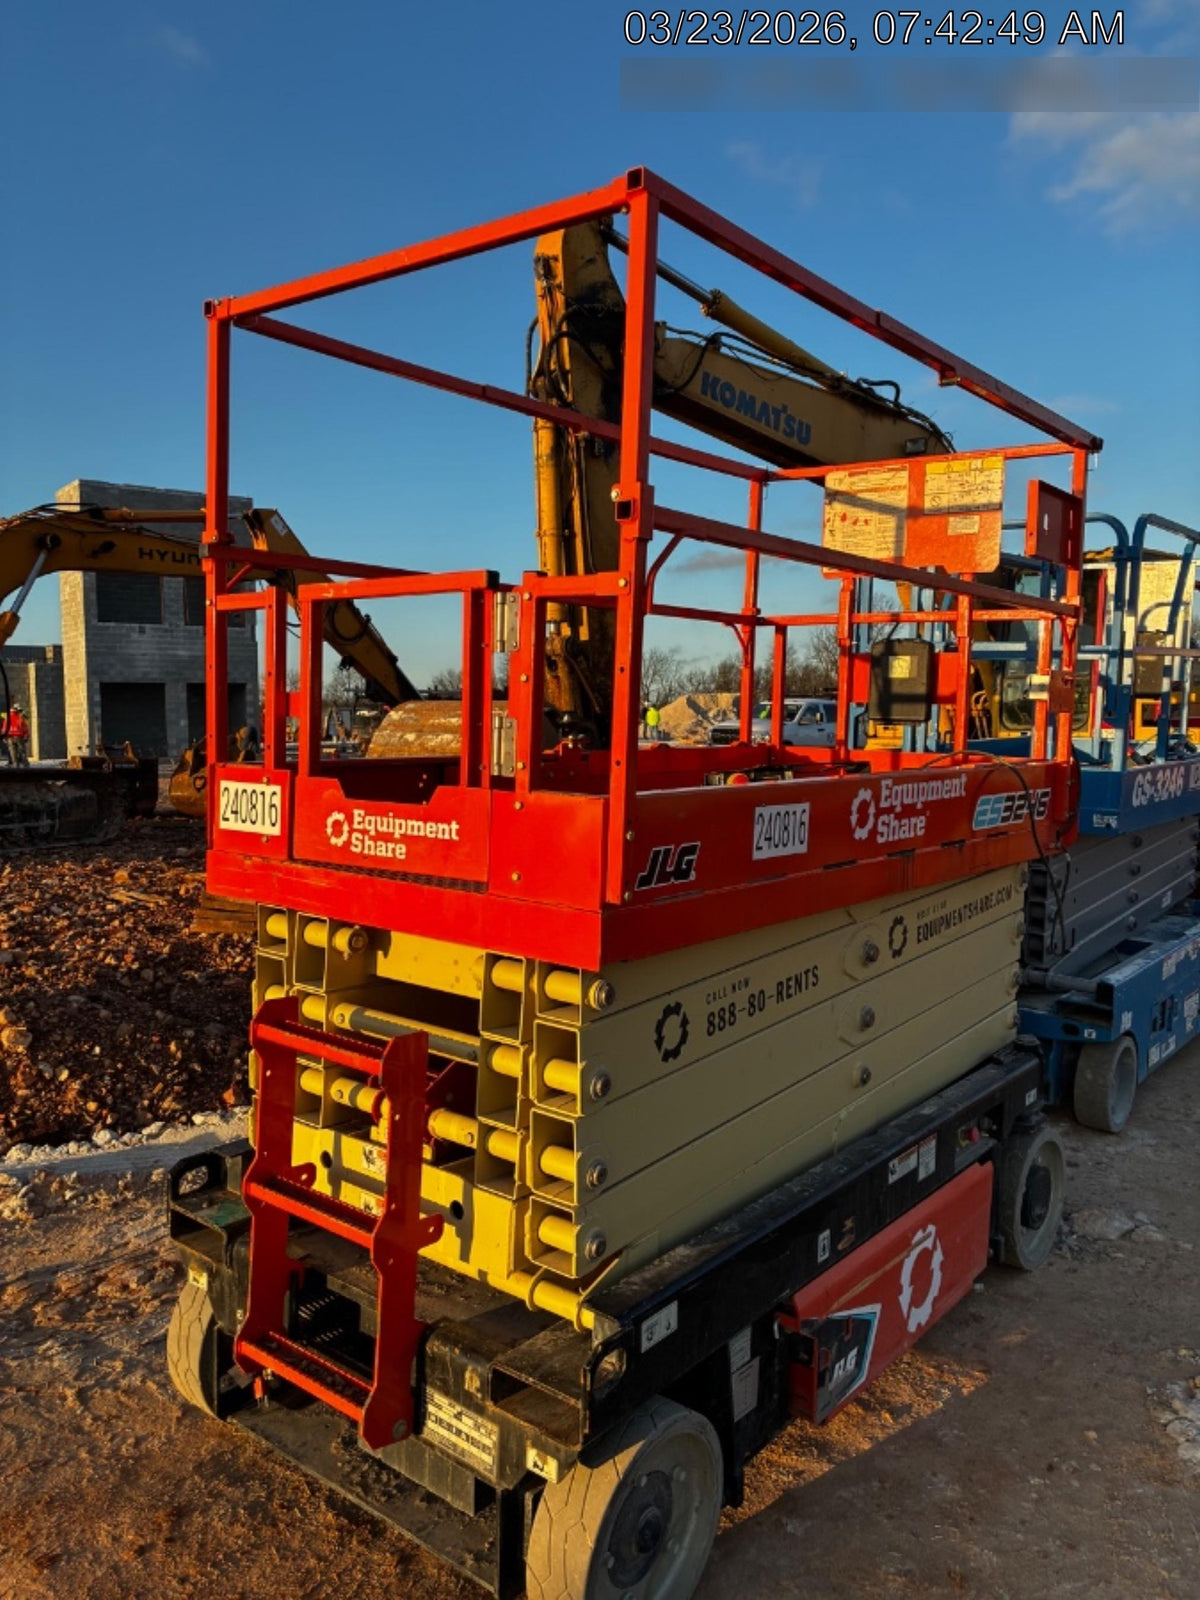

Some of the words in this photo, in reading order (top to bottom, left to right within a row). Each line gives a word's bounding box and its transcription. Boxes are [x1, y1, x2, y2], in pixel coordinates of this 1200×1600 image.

[700, 371, 812, 446] KOMATSU
[221, 786, 278, 828] 240816
[879, 774, 968, 813] Equipment
[352, 808, 460, 841] Equipment
[755, 808, 807, 851] 240816
[876, 814, 926, 843] Share
[350, 831, 406, 860] Share
[634, 841, 701, 891] JLG
[705, 987, 728, 1005] CALL
[706, 965, 820, 1037] 888-80-RENTS
